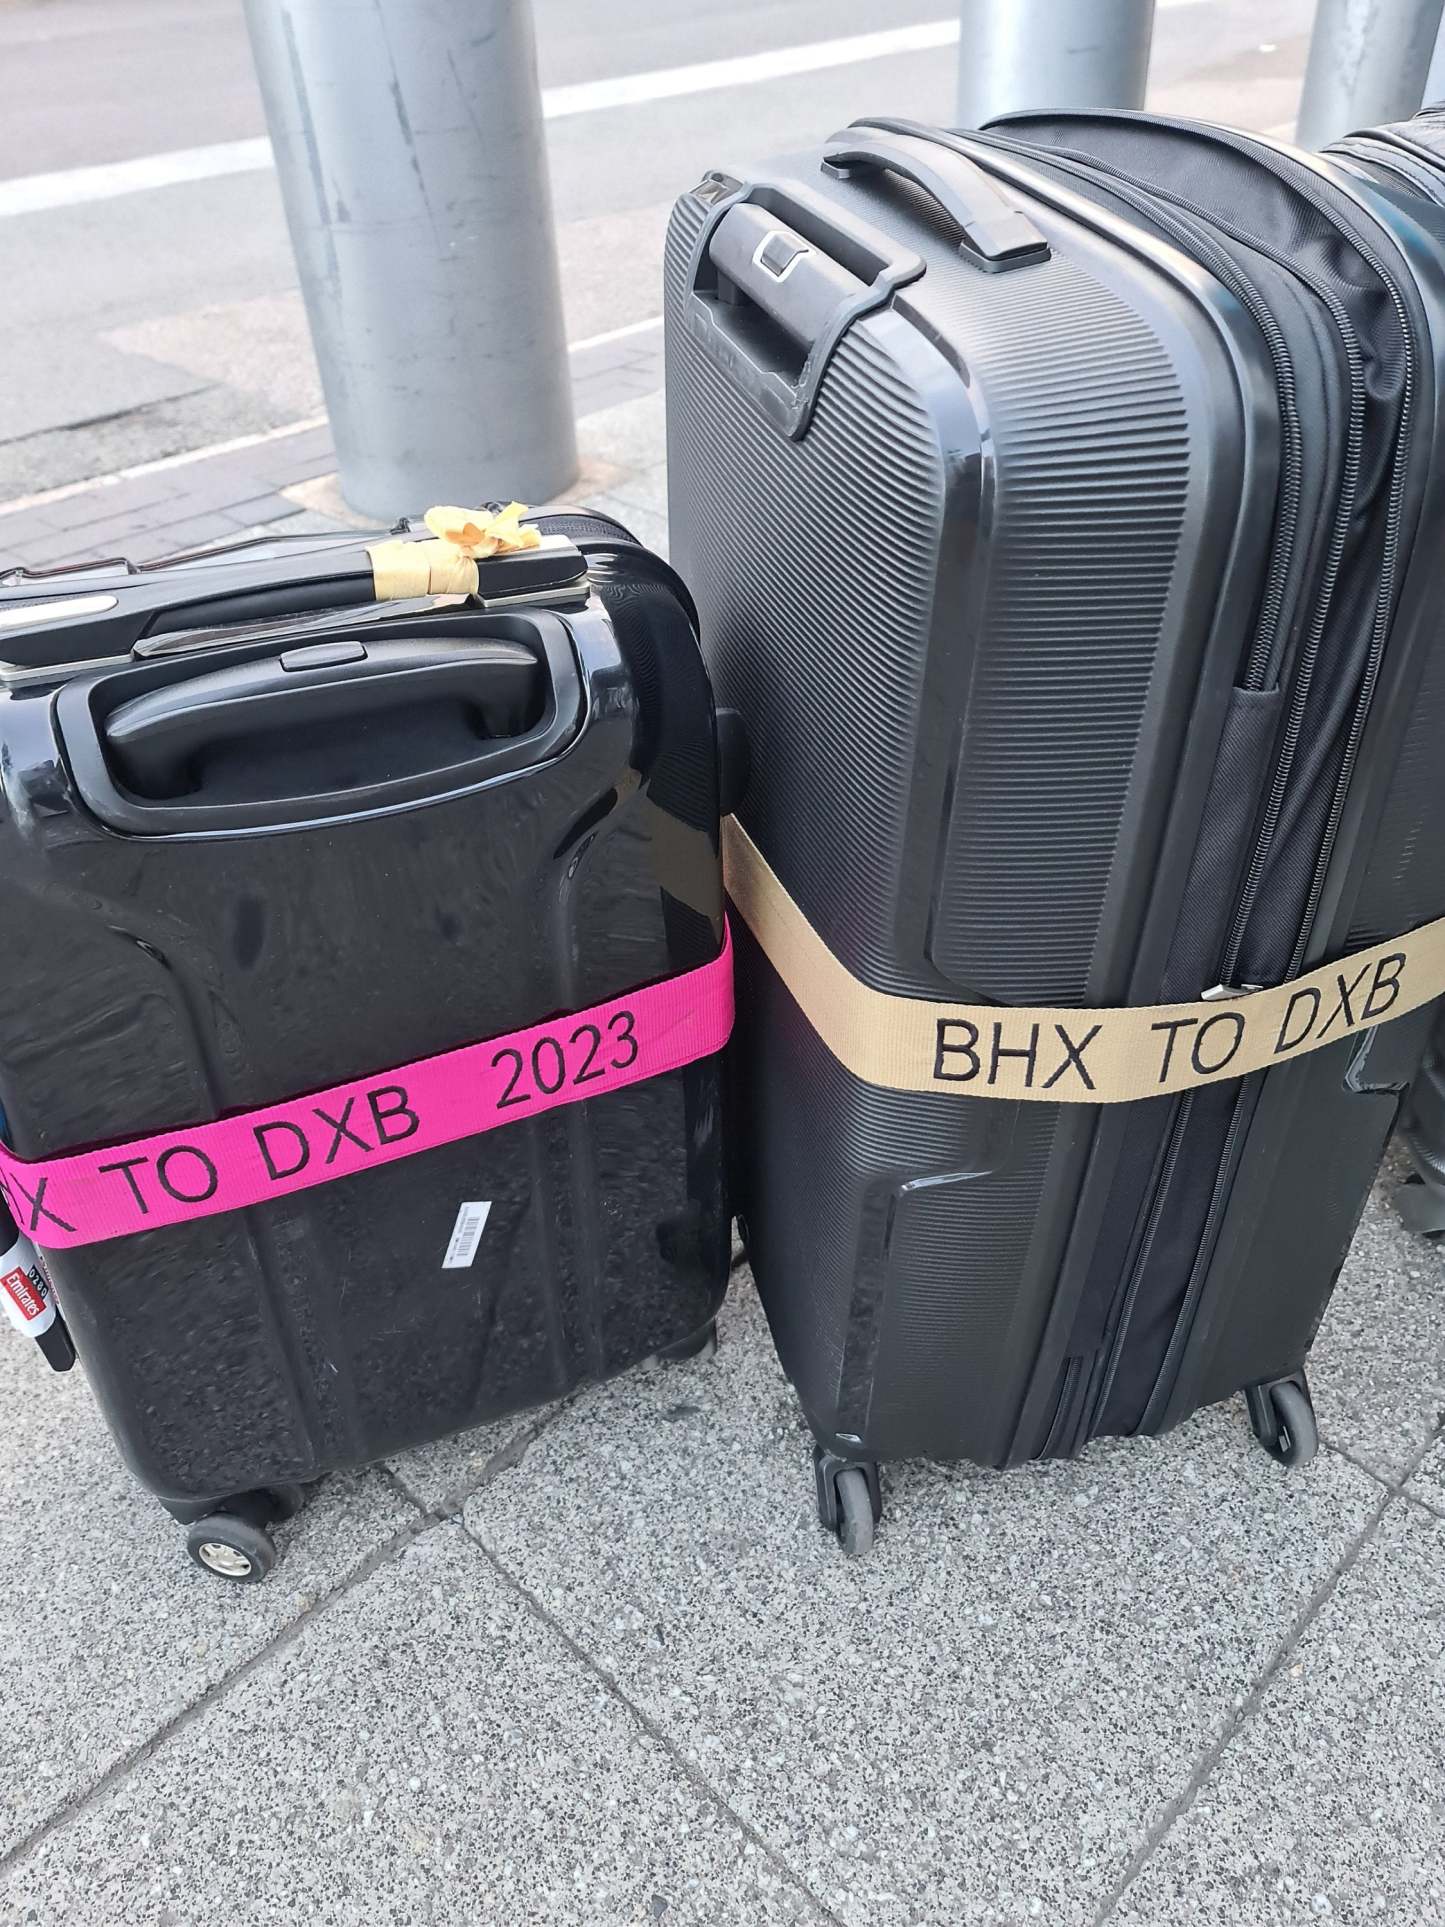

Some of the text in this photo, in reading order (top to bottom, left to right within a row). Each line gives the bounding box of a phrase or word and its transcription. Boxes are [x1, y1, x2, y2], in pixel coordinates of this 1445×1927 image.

[933, 952, 1407, 1091] BHX TO DXB
[99, 1144, 218, 1214] TO
[253, 1085, 420, 1180] DXB
[490, 1010, 640, 1109] 2023
[6, 1272, 40, 1316] Emirates
